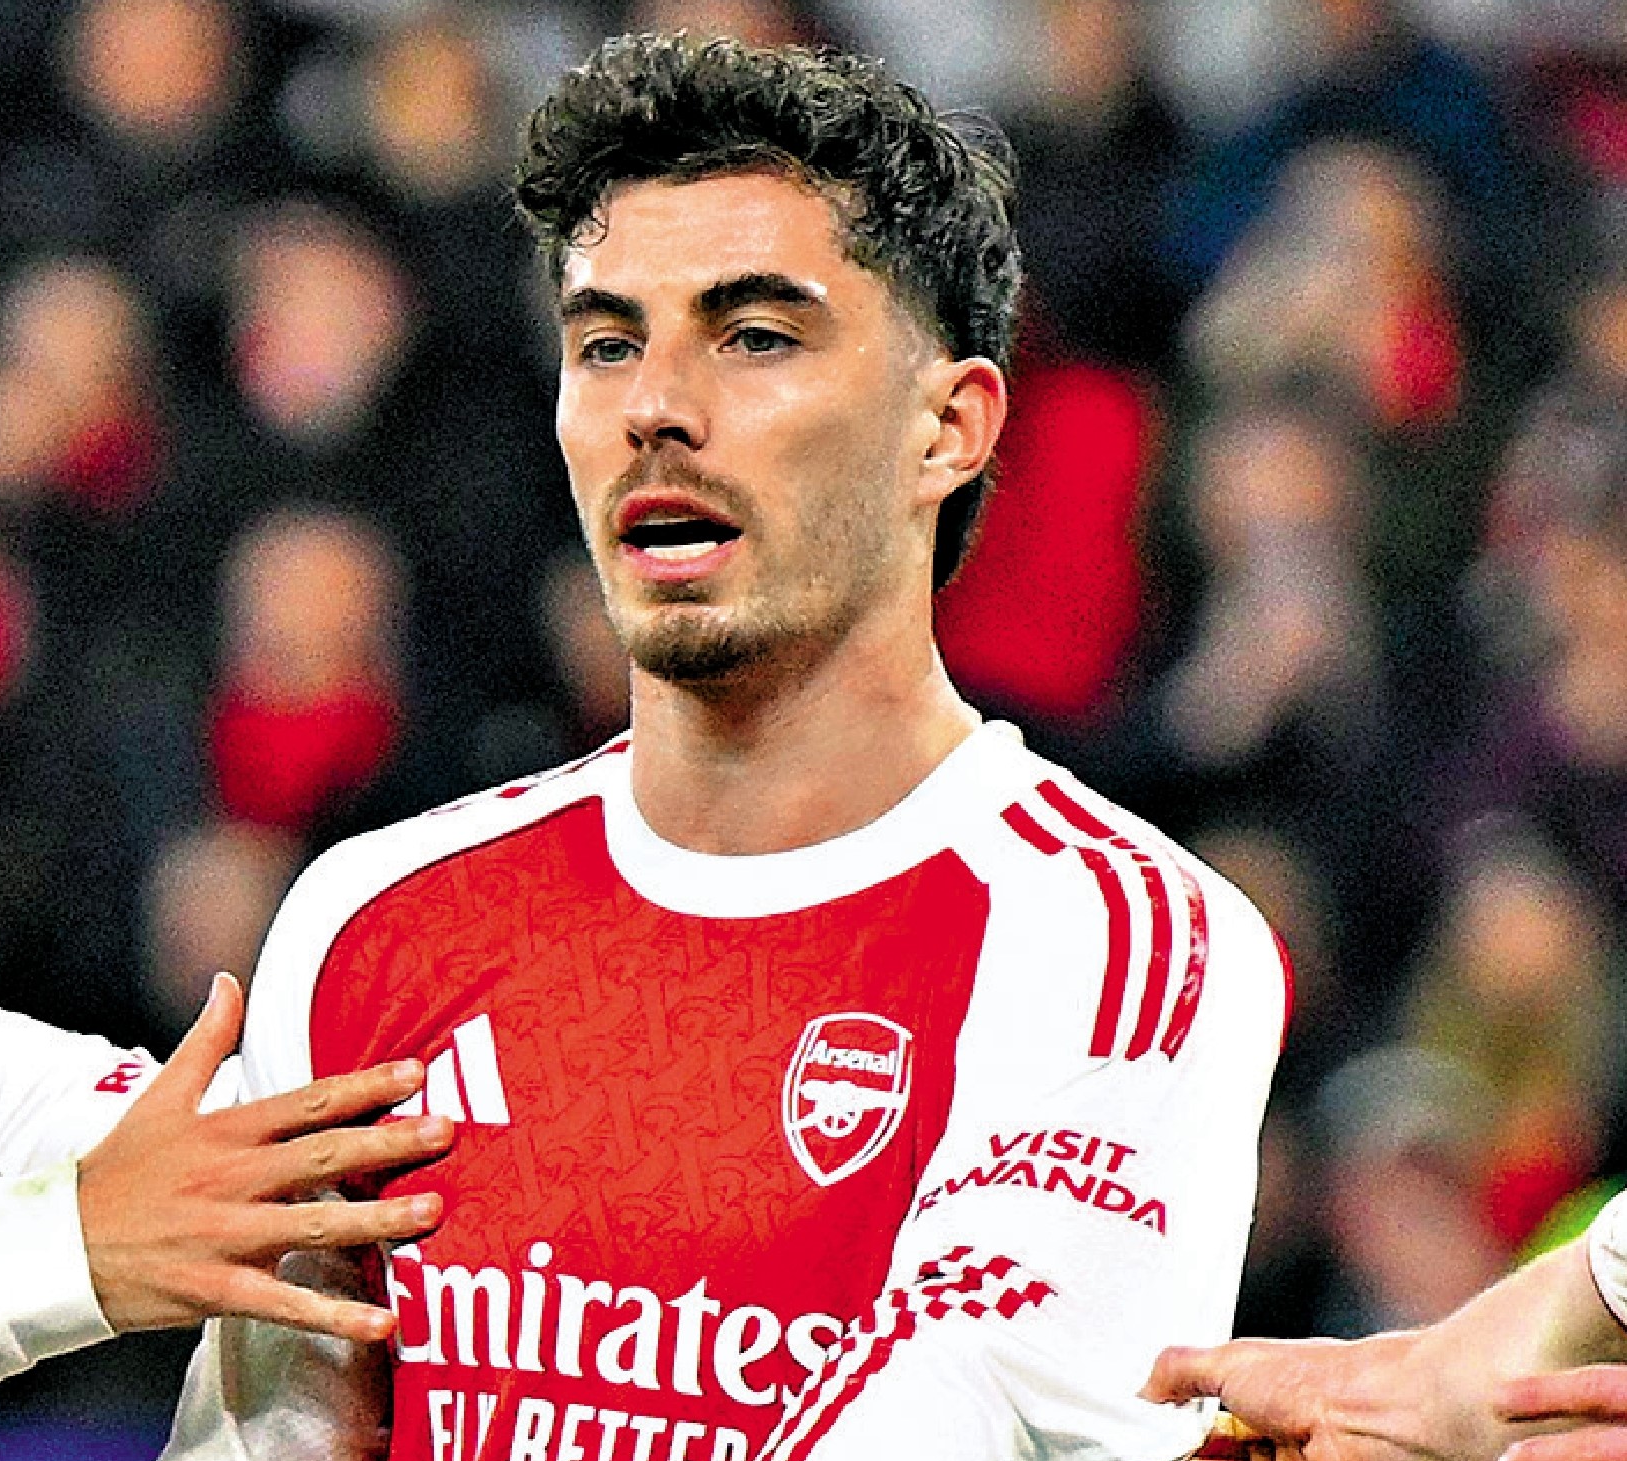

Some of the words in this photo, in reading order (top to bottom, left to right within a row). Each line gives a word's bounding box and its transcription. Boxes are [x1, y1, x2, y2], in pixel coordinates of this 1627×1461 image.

[806, 1038, 897, 1076] Arsenal
[989, 1129, 1137, 1174] VISIT
[387, 1240, 845, 1417] Emirates
